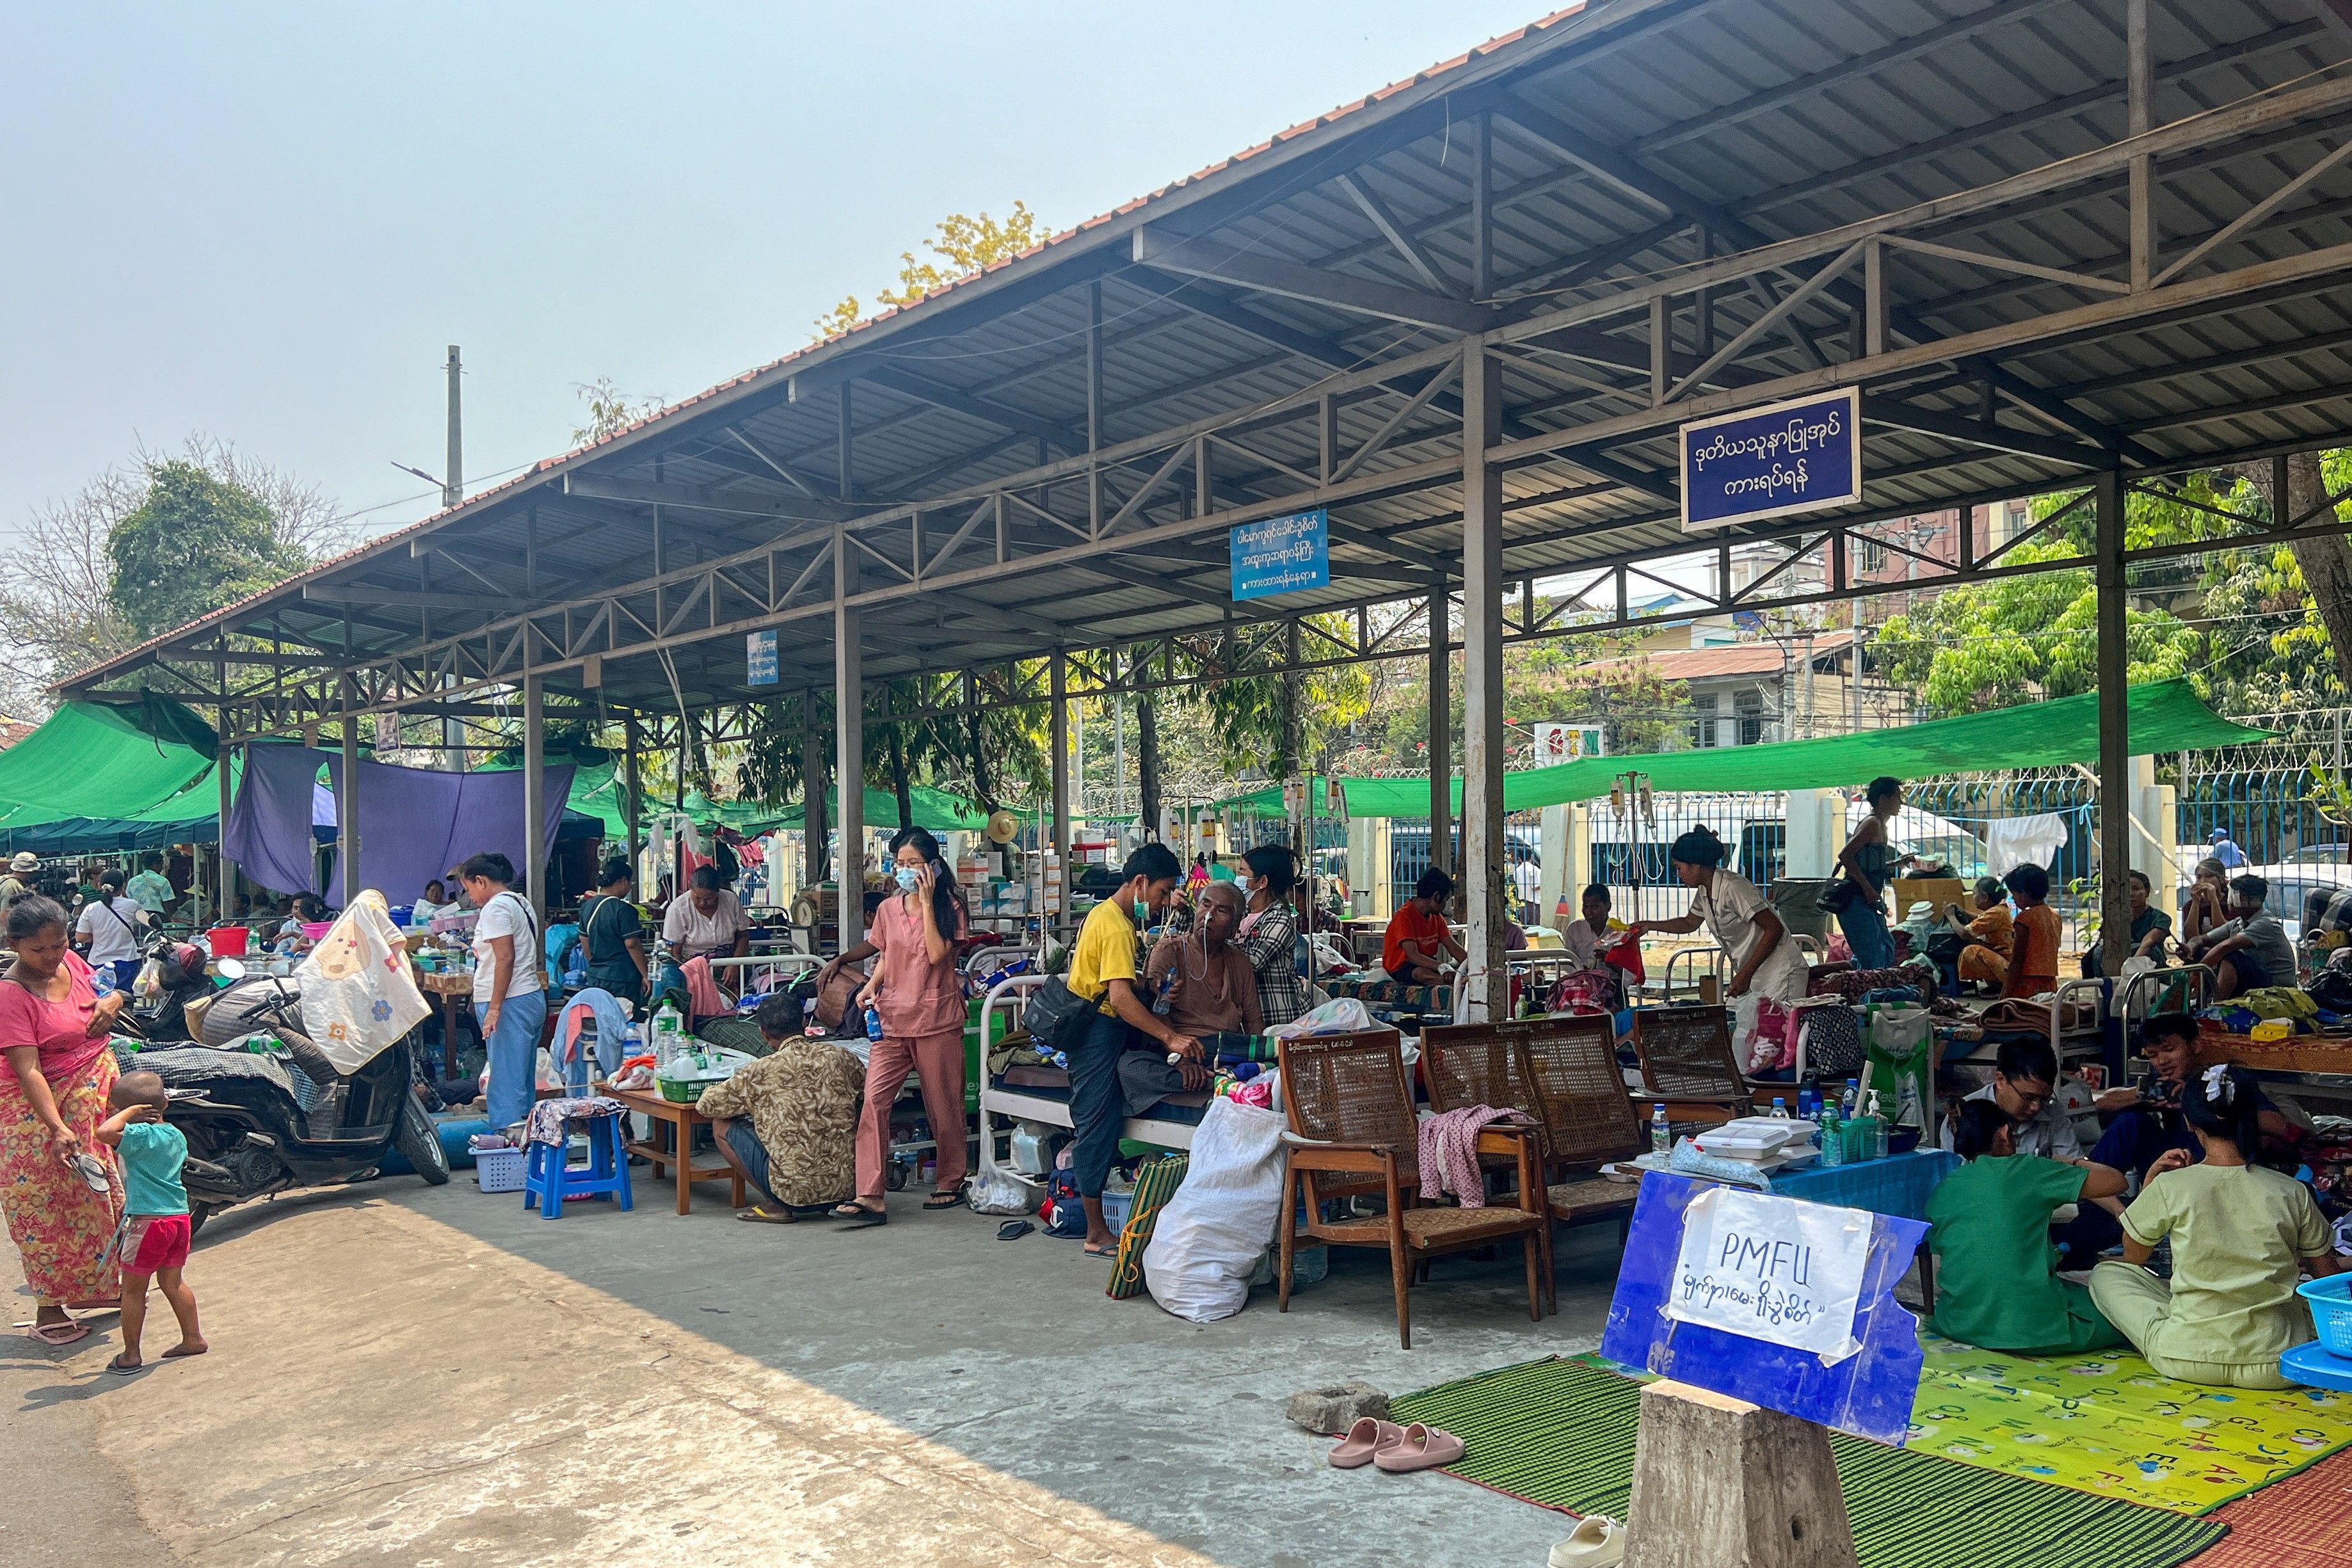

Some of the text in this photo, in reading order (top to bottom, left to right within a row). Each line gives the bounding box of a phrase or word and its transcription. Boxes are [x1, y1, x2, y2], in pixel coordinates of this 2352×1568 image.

[1695, 411, 1840, 472] ဒုတိယသူနာပြုအုပ်
[1724, 458, 1809, 497] ကားရပ်ရန်
[1720, 1233, 1812, 1289] PMFU
[2227, 1416, 2259, 1425] G
[2186, 1430, 2219, 1444] H
[2295, 1428, 2326, 1437] C
[2145, 1452, 2179, 1464] E
[2204, 1464, 2238, 1475] A
[2096, 1471, 2125, 1482] F
